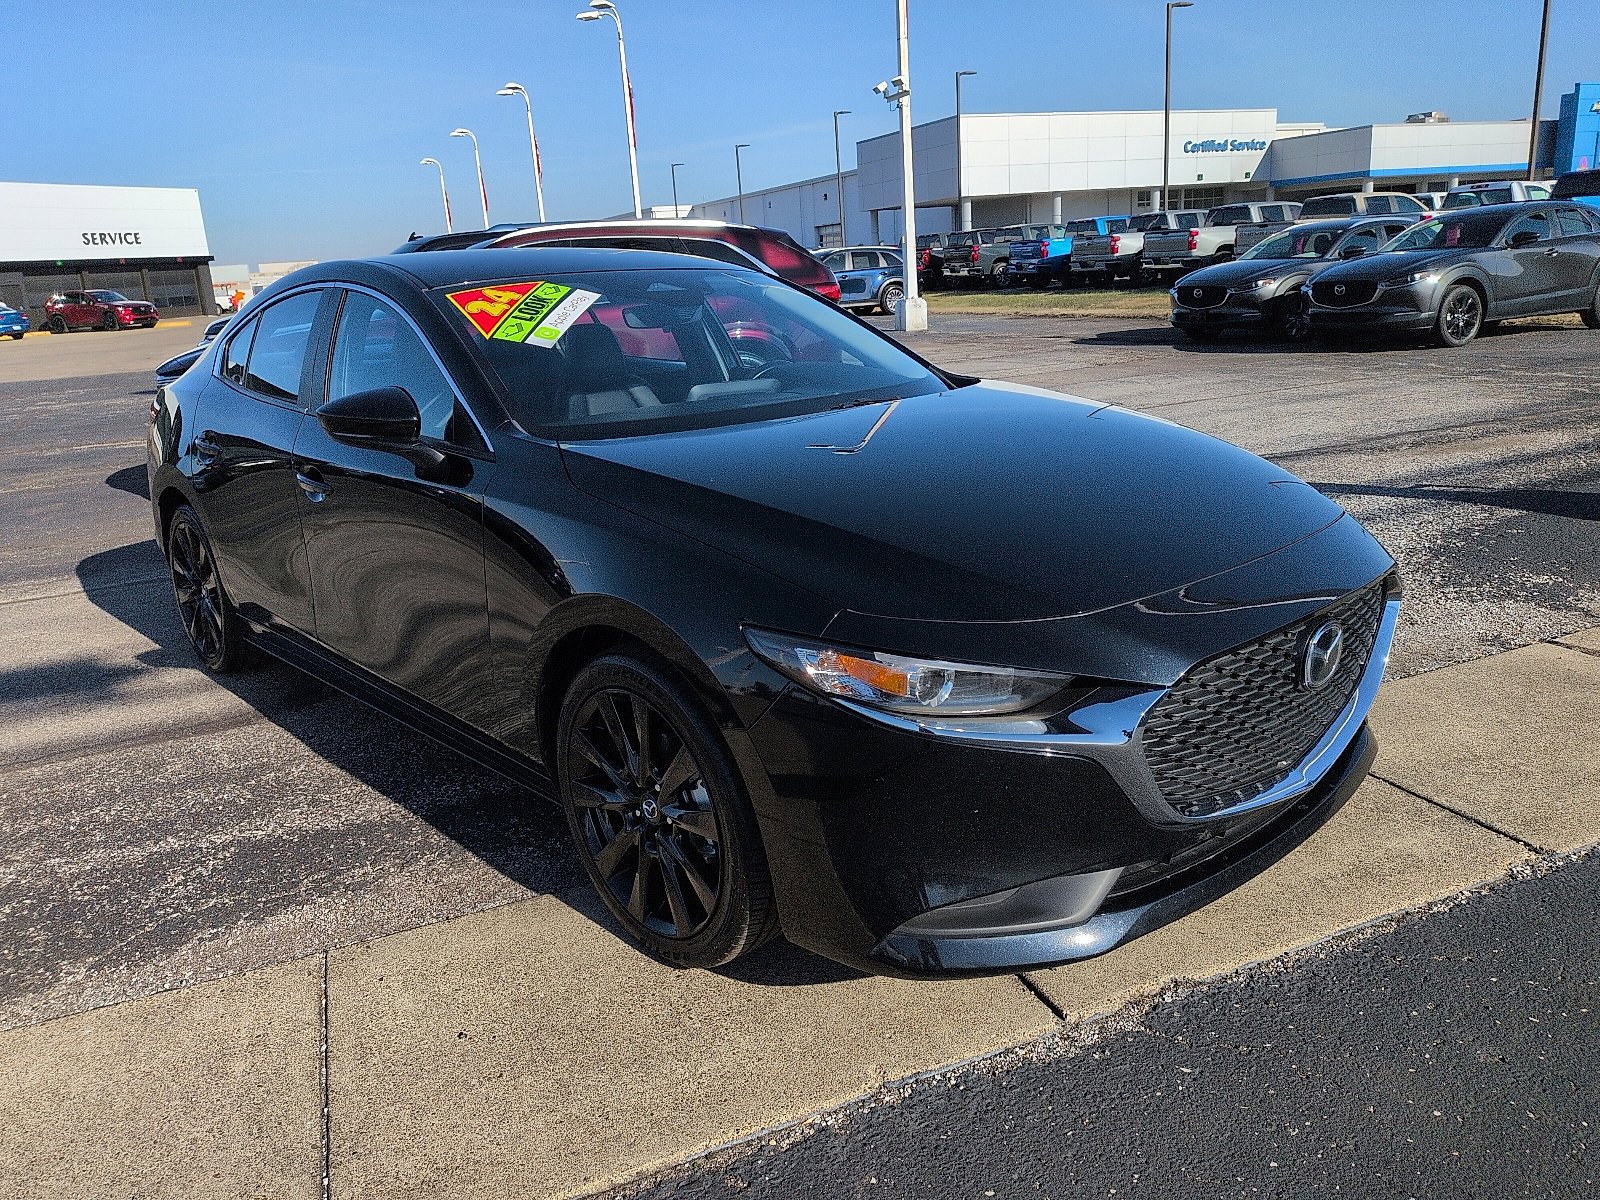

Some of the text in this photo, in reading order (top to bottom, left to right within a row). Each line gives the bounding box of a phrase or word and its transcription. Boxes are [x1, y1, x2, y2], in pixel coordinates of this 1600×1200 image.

[1183, 138, 1267, 153] Certified Service
[81, 232, 142, 246] SERVICE
[464, 287, 523, 317] 24
[510, 294, 553, 323] LOOK
[548, 311, 571, 329] Apple
